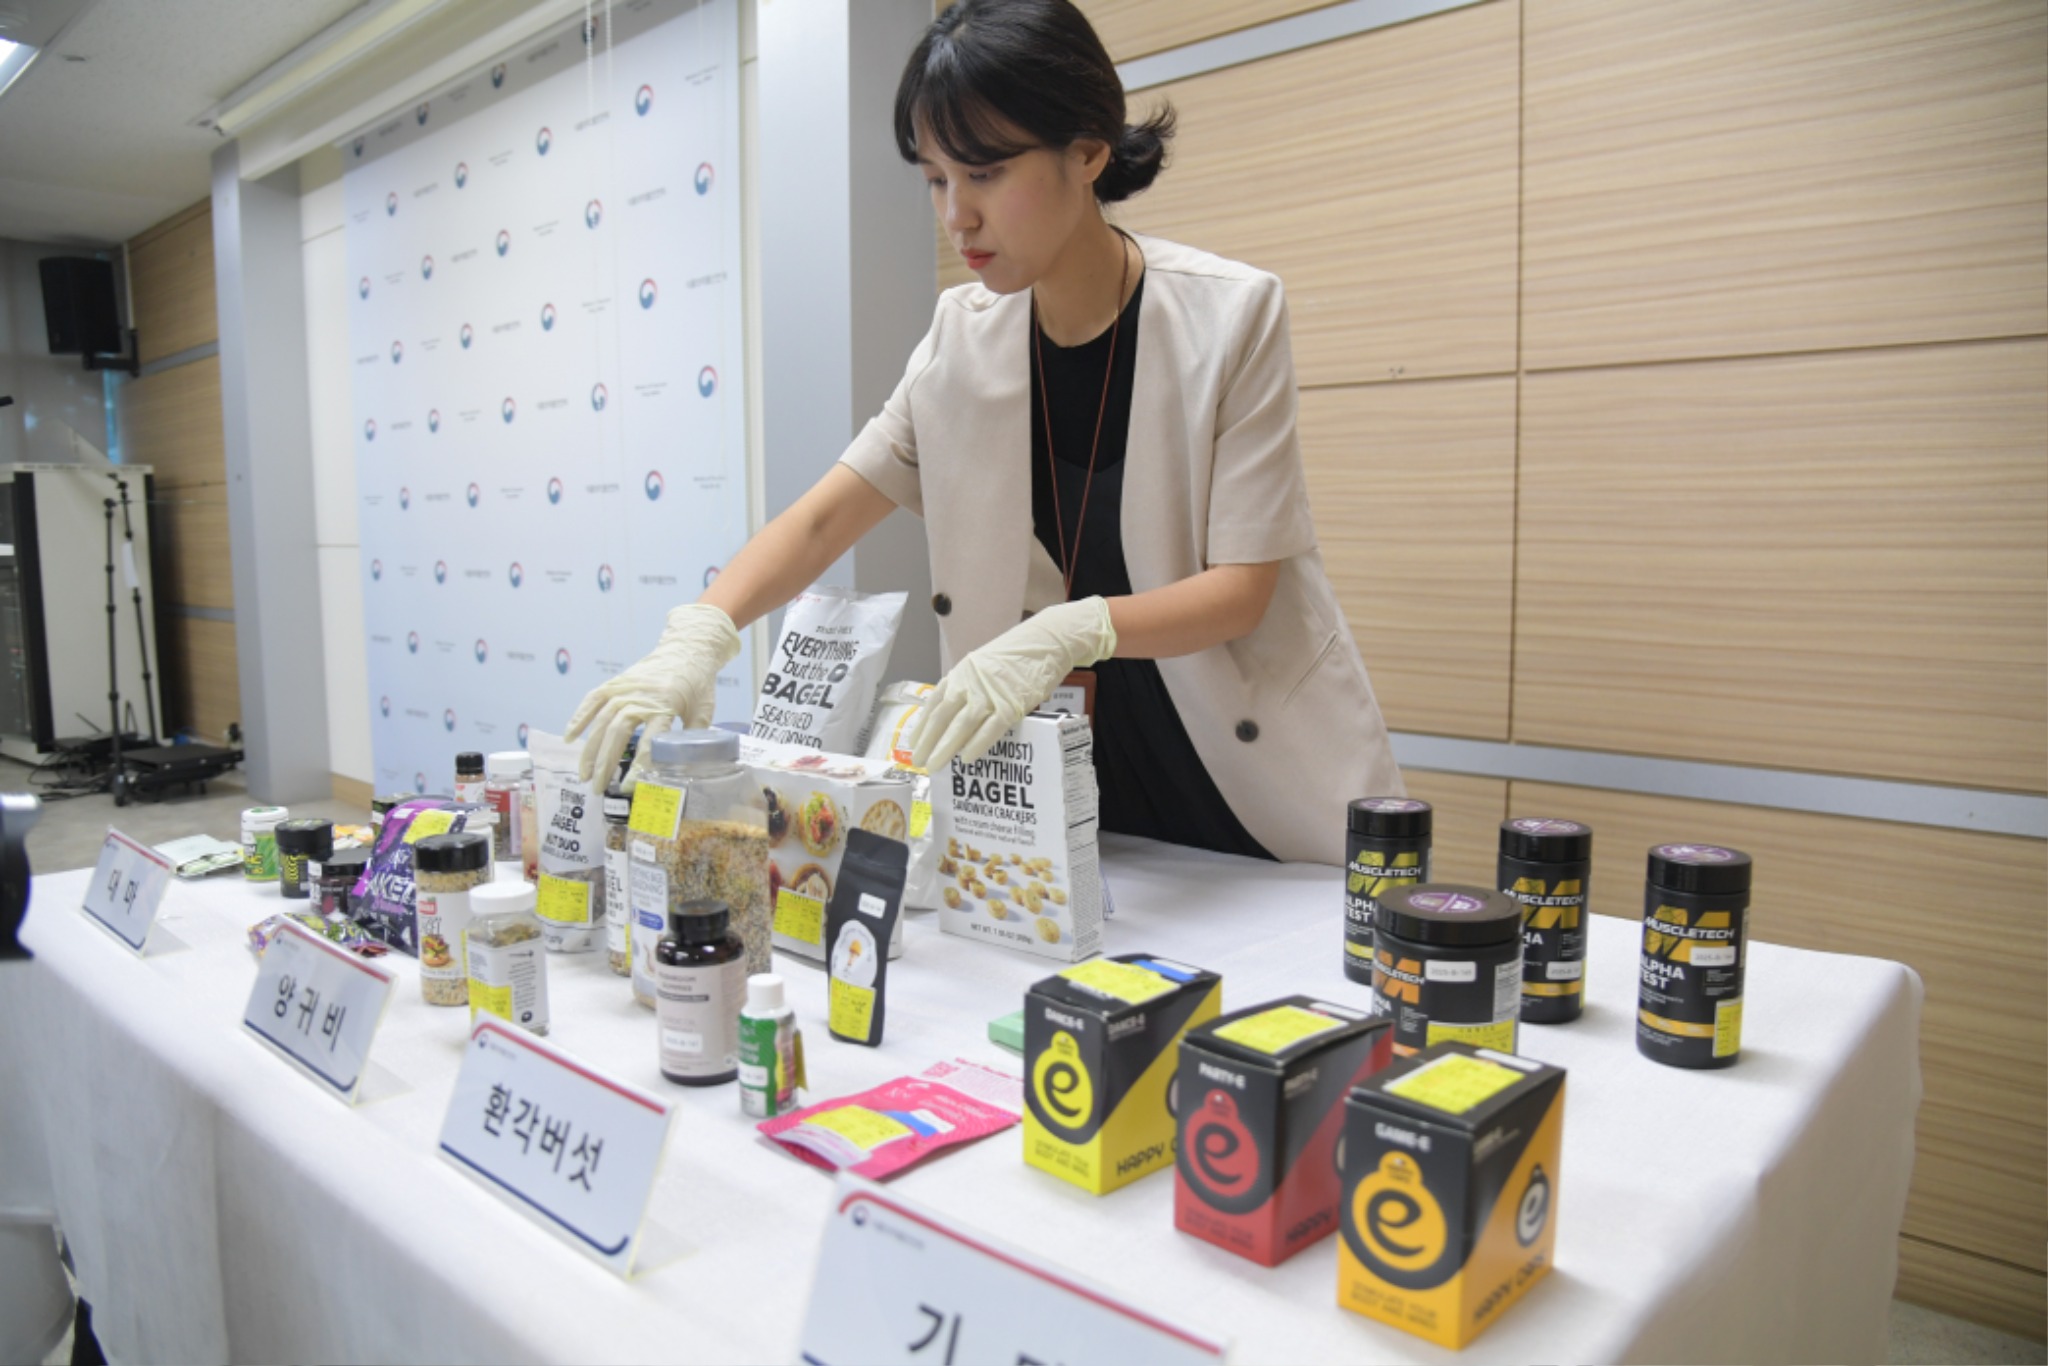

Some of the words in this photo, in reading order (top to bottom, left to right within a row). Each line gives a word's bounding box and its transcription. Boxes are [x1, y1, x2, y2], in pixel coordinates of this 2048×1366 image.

[782, 659, 810, 680] but
[808, 662, 829, 681] the
[761, 673, 834, 709] BAGEL
[951, 755, 1033, 786] EVERYTHING
[953, 775, 1035, 809] BAGEL
[953, 798, 994, 817] SANDWICH
[995, 806, 1037, 825] CRACKERS
[954, 816, 969, 826] with
[970, 819, 989, 829] cream
[989, 821, 1013, 833] cheese
[1014, 825, 1036, 840] filling
[1348, 861, 1423, 877] MUSCLETECH
[971, 923, 981, 931] NET
[1645, 916, 1735, 940] MUSCLETECH
[1640, 954, 1685, 980] ALPHA
[1640, 968, 1669, 989] TEST
[1199, 1062, 1246, 1089] PARTY-E
[1043, 1061, 1082, 1118] e
[484, 1083, 603, 1191] 환각버섯
[1116, 1140, 1166, 1176] HAPPY
[1195, 1123, 1243, 1185] e
[1366, 1188, 1426, 1257] e
